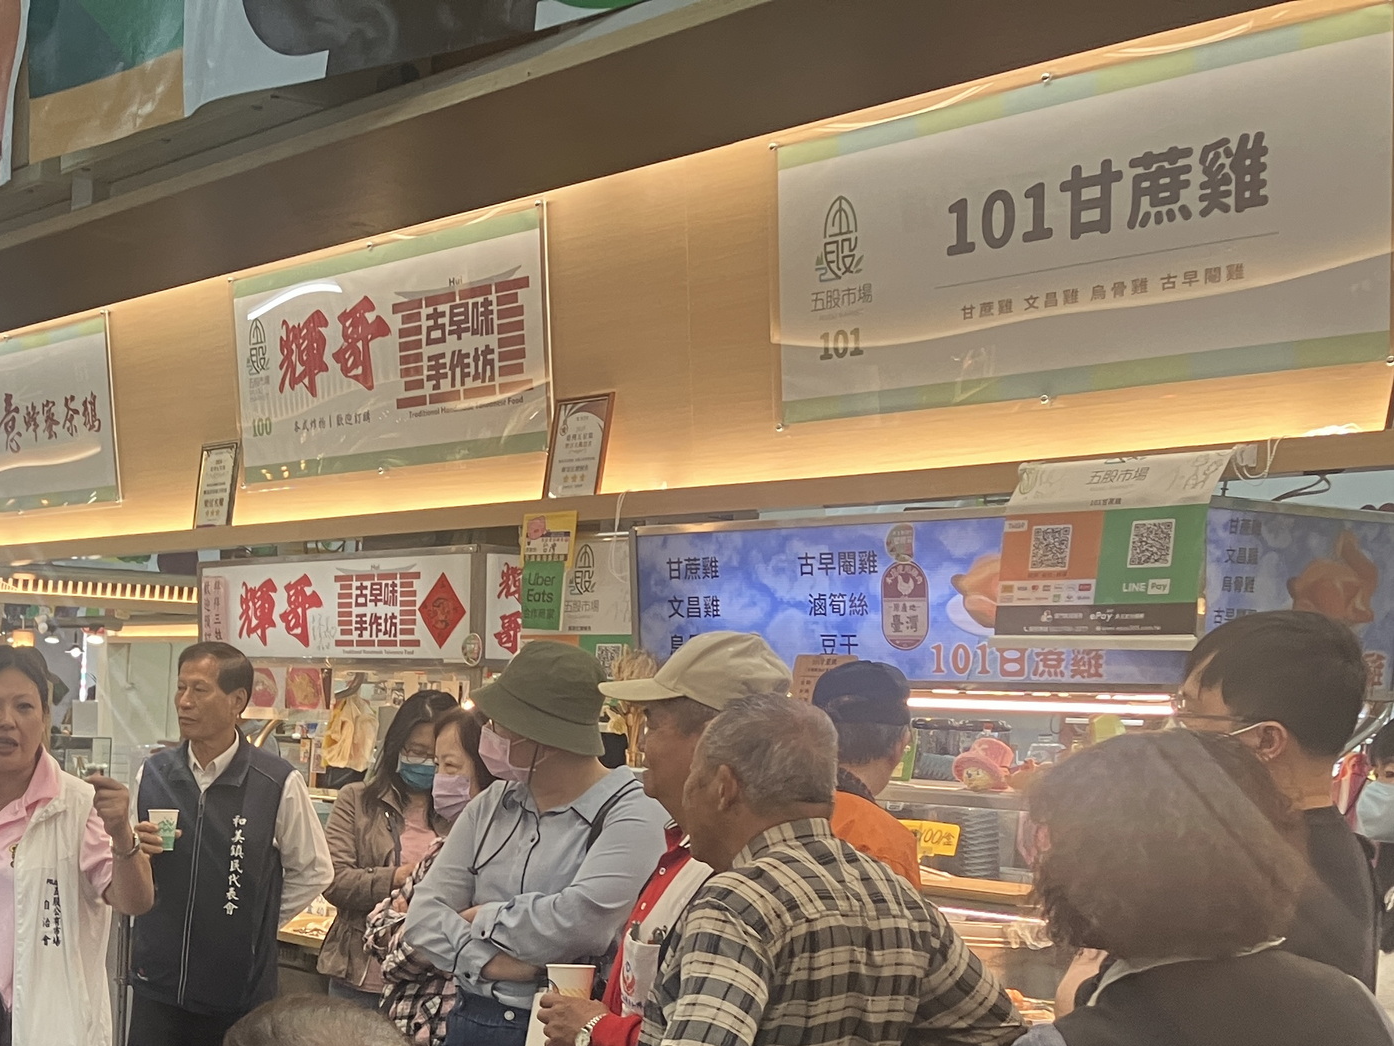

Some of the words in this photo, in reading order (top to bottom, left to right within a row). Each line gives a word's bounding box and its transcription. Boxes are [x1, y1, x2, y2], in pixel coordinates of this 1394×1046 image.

[946, 131, 1269, 257] 101甘蔗雞
[811, 283, 873, 313] 五股市場
[961, 298, 1013, 321] 甘蔗雞
[1024, 288, 1079, 312] 文昌雞
[425, 297, 494, 347] 古早味
[278, 295, 392, 398] 輝哥
[819, 327, 864, 361] 101
[426, 344, 495, 391] 手作坊
[1087, 467, 1150, 485] 五股市場
[666, 556, 720, 581] 甘蔗雞
[797, 550, 879, 577] 古早閹雞
[527, 572, 557, 587] Uber
[1123, 583, 1146, 592] LINE
[1151, 582, 1170, 591] Pay
[354, 580, 397, 608] 古早味
[526, 589, 554, 603] Eats
[564, 600, 600, 613] 五股市場
[667, 595, 721, 619] 文昌雞
[808, 593, 868, 617] 滷筍絲
[238, 573, 324, 648] 輝哥
[354, 612, 397, 639] 手作坊
[223, 815, 247, 916] 和美鎮民代表會
